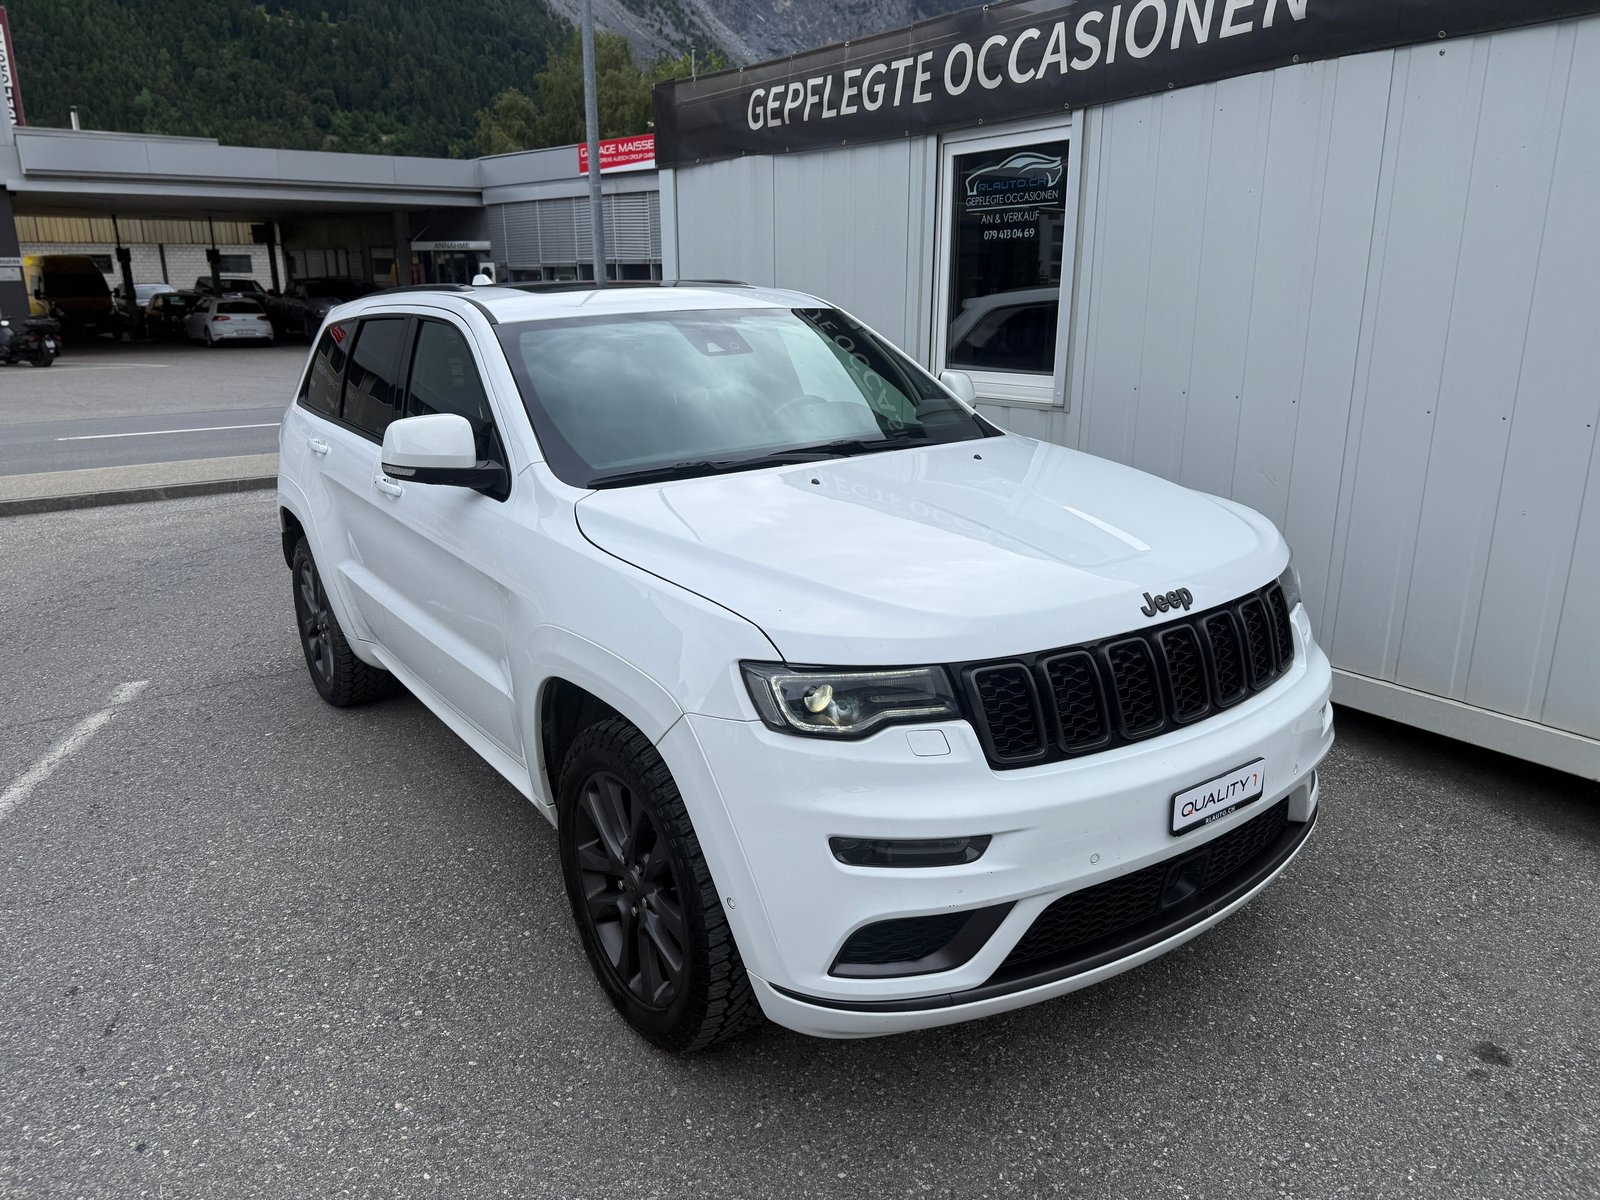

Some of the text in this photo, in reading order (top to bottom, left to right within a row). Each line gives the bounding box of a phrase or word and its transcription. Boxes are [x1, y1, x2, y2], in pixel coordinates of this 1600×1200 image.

[747, 51, 933, 130] GEPFLEGTE
[580, 143, 617, 158] GAGE
[966, 189, 1059, 207] GEPFLEGTE OCCASIONEN
[981, 210, 1040, 224] AN & VERKAUF
[983, 227, 1035, 240] 079 413 04 69
[1140, 587, 1194, 617] Jeep
[1181, 773, 1258, 818] QUALITY 1
